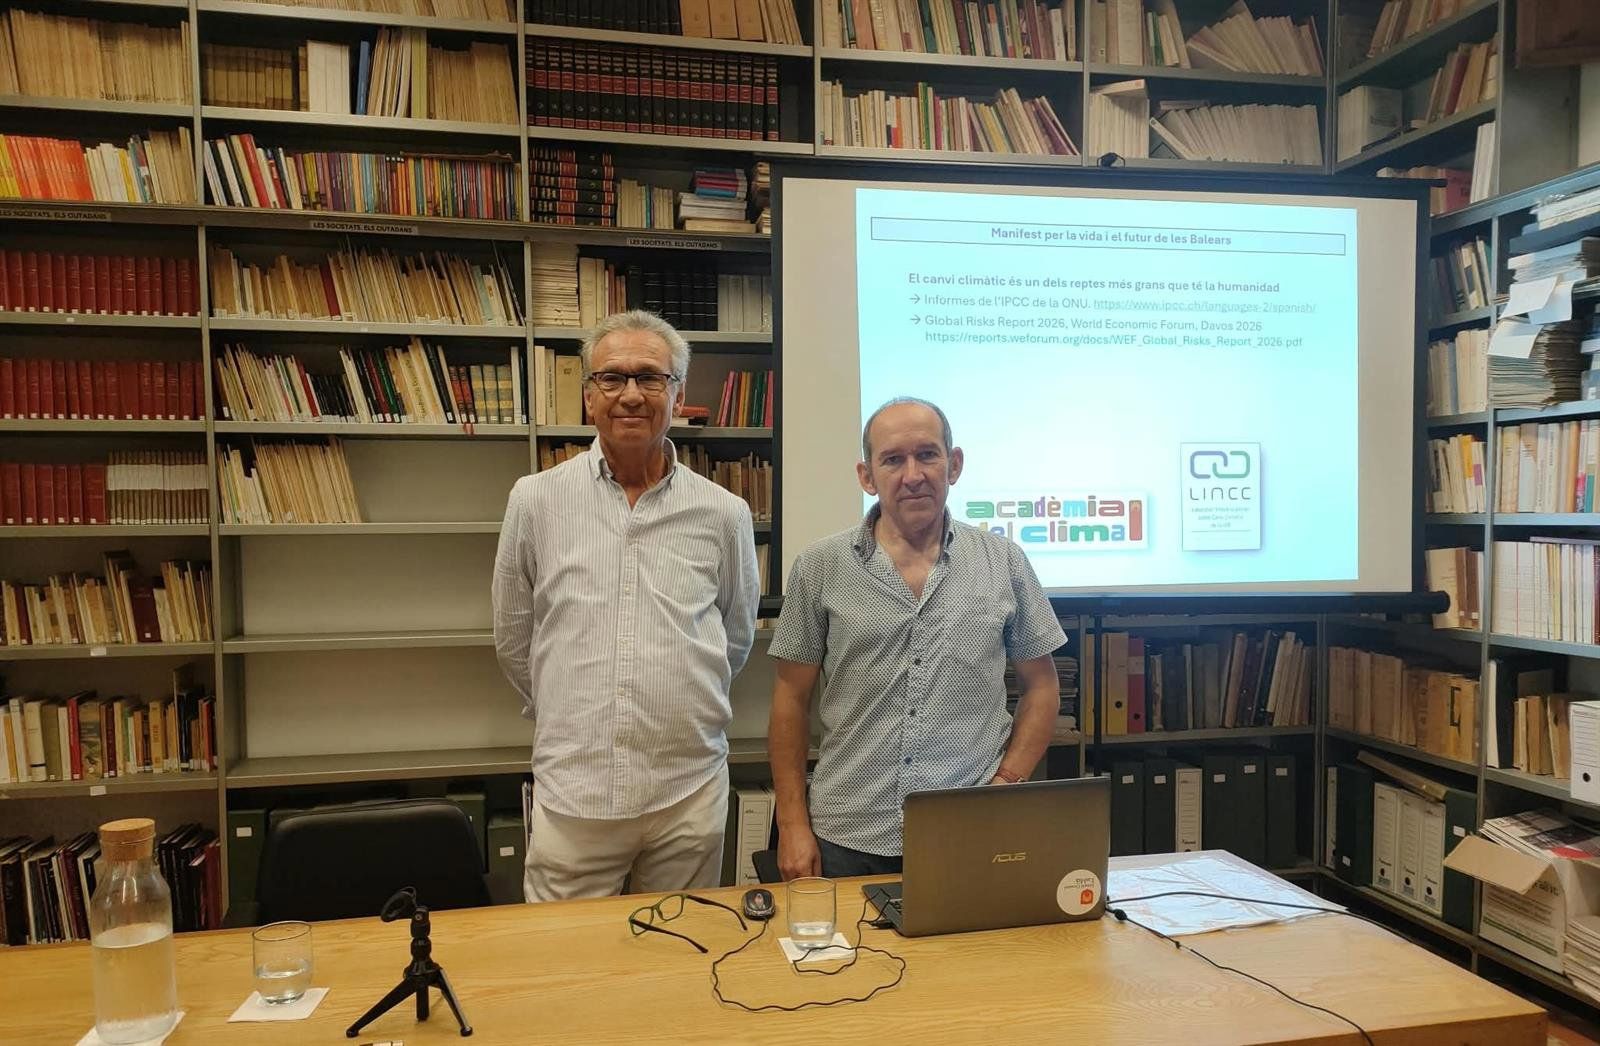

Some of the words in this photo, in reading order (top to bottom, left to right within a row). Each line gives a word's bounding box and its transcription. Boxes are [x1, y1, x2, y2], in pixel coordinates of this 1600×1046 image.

[991, 228, 1041, 240] Manifest
[1045, 231, 1064, 242] per
[1066, 230, 1077, 241] la
[1079, 231, 1103, 242] vida
[1111, 232, 1122, 242] el
[1124, 232, 1152, 243] futur
[1154, 233, 1168, 243] de
[1171, 233, 1188, 244] les
[1190, 234, 1232, 246] Balears
[909, 273, 921, 284] El
[923, 274, 955, 285] canvi
[958, 274, 1006, 287] climàtic
[1009, 276, 1023, 287] és
[1025, 279, 1040, 287] un
[1043, 277, 1068, 288] dels
[1070, 279, 1106, 291] reptes
[1108, 279, 1133, 289] més
[1135, 281, 1165, 292] grans
[1168, 282, 1190, 293] que
[1192, 280, 1203, 291] té
[1205, 281, 1216, 291] la
[1218, 281, 1280, 293] humanidad
[924, 294, 976, 307] Informes
[978, 295, 992, 307] de
[1032, 297, 1047, 308] de
[1049, 297, 1059, 309] la
[1062, 298, 1092, 310] ONU.
[925, 315, 964, 327] Global
[966, 316, 996, 327] Risks
[998, 316, 1035, 329] Report
[1038, 318, 1069, 330] 2026,
[1071, 318, 1103, 330] World
[1105, 319, 1158, 331] Economic
[1160, 319, 1198, 332] Forum,
[1201, 320, 1234, 331] Davos
[1236, 320, 1263, 332] 2026
[925, 331, 1303, 347] https://reports.weforum.org/docs/WEF_Global_Risks_Report_2026pdf
[1190, 487, 1251, 501] LINCC
[966, 495, 1125, 519] acadèmia
[1020, 520, 1126, 543] clima
[992, 852, 1026, 863] ASUS
